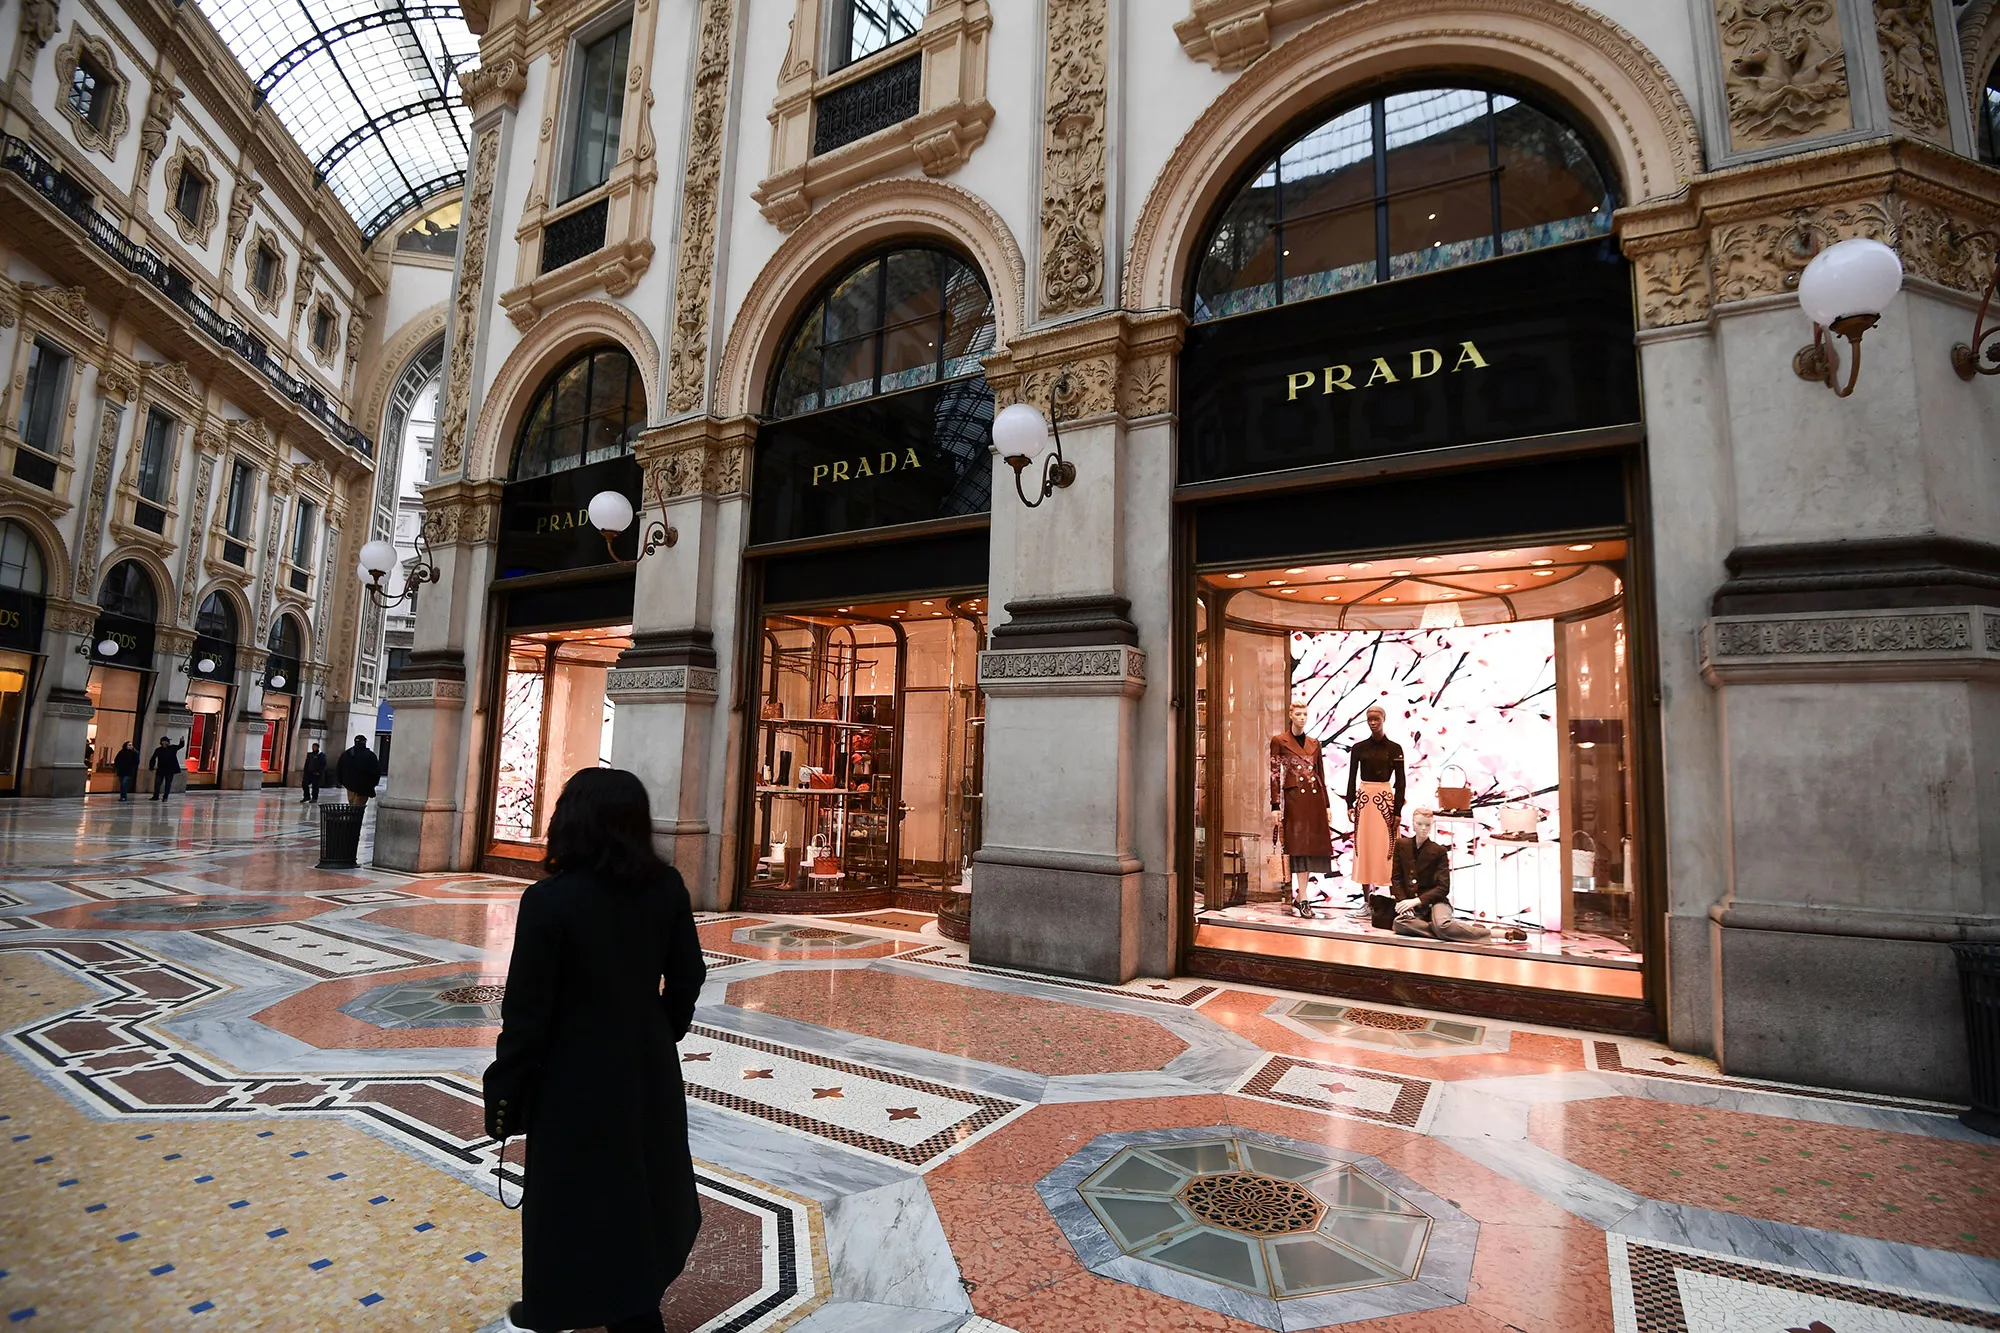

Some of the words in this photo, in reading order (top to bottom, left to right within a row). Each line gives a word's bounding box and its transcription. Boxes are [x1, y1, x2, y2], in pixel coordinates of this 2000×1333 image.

[1287, 340, 1490, 402] PRADA
[812, 447, 922, 486] PRADA
[536, 508, 589, 534] PRAD
